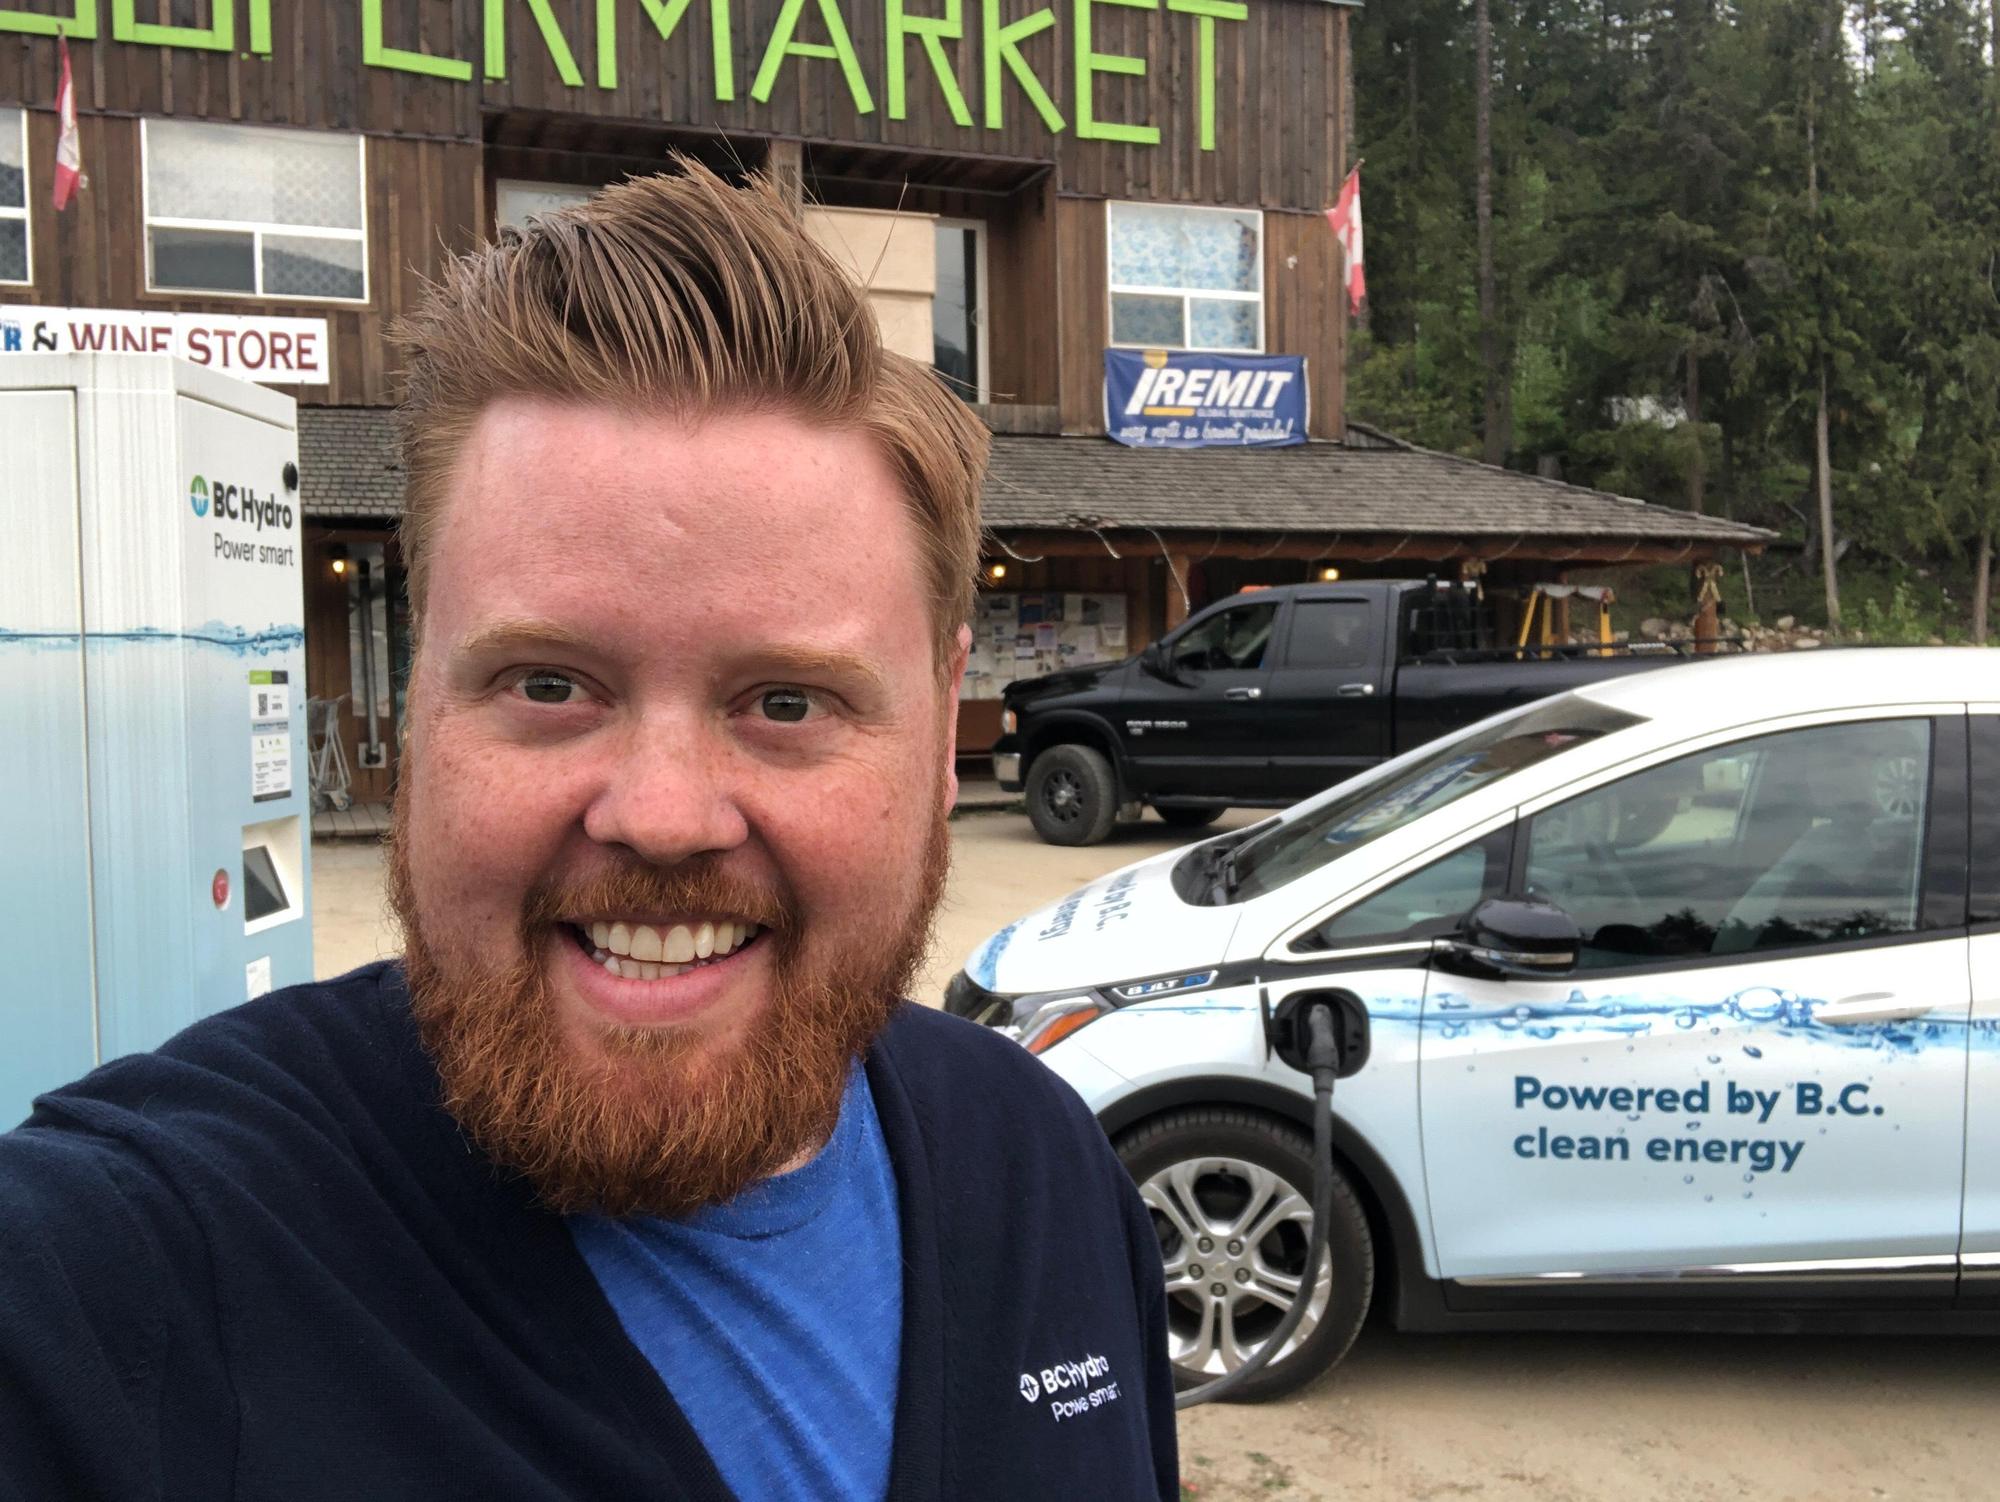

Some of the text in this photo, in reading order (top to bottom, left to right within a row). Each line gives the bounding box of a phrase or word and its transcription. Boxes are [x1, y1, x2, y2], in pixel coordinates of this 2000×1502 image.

[0, 0, 1249, 151] RMARKET
[188, 328, 318, 371] STORE
[214, 532, 294, 567] Power smart
[1514, 1076, 1885, 1123] Powered by B.C.
[1513, 1128, 1805, 1173] clean energy
